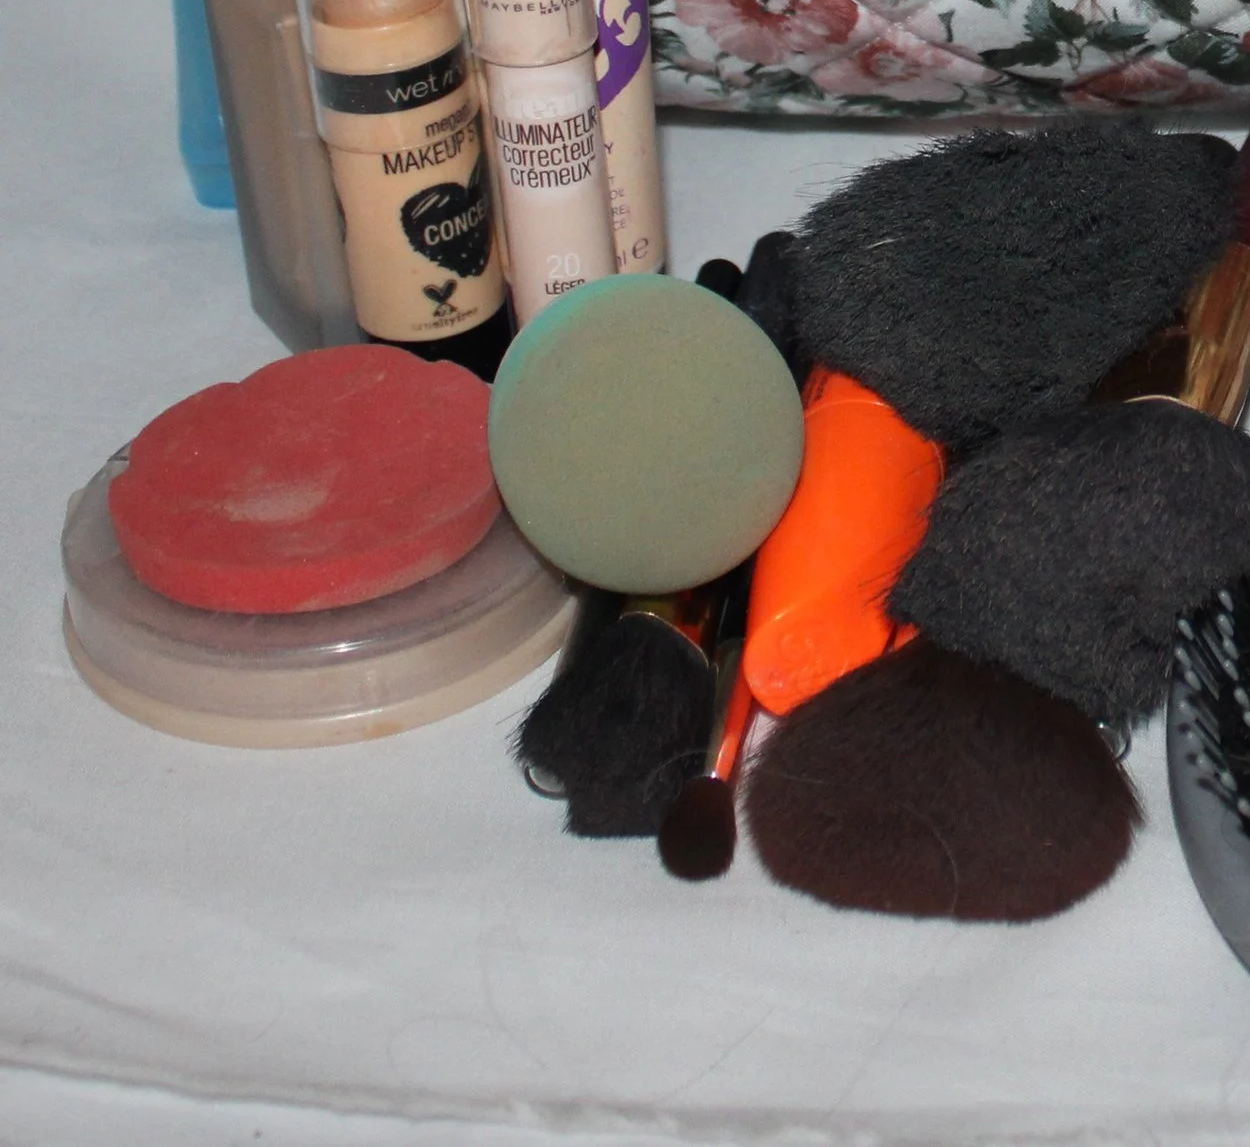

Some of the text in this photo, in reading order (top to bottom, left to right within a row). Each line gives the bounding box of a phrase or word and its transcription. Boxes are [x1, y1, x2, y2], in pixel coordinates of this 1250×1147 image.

[386, 73, 439, 103] wet
[382, 129, 465, 175] MAKEUP
[503, 134, 593, 167] correcteur
[424, 199, 488, 246] CONCE
[546, 254, 581, 279] 20
